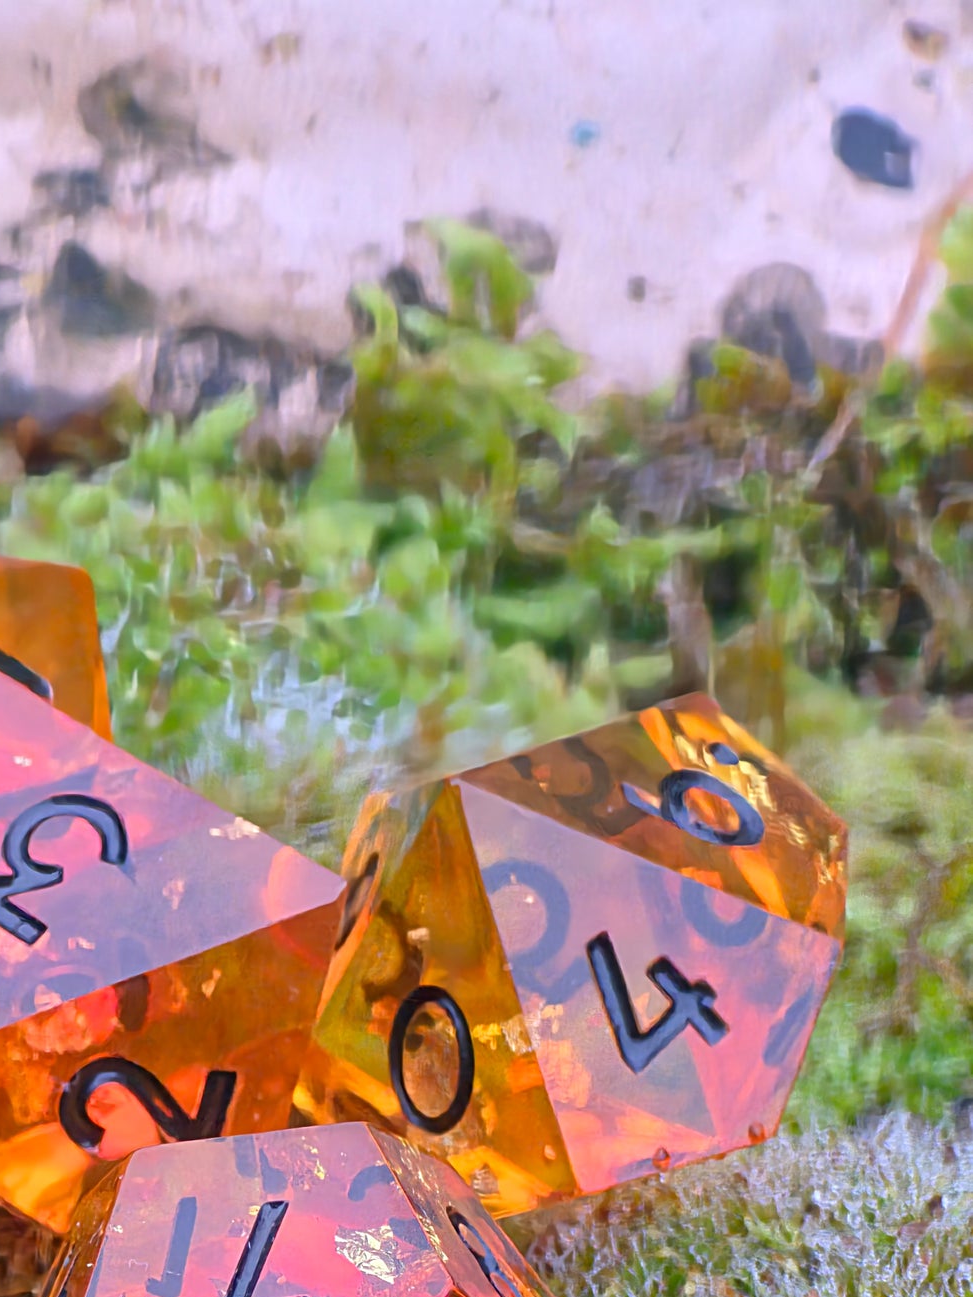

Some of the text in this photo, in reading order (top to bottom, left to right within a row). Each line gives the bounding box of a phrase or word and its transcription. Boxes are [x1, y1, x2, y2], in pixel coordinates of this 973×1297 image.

[389, 984, 475, 1135] 0
[585, 930, 730, 1074] 4
[59, 1057, 237, 1147] 2
